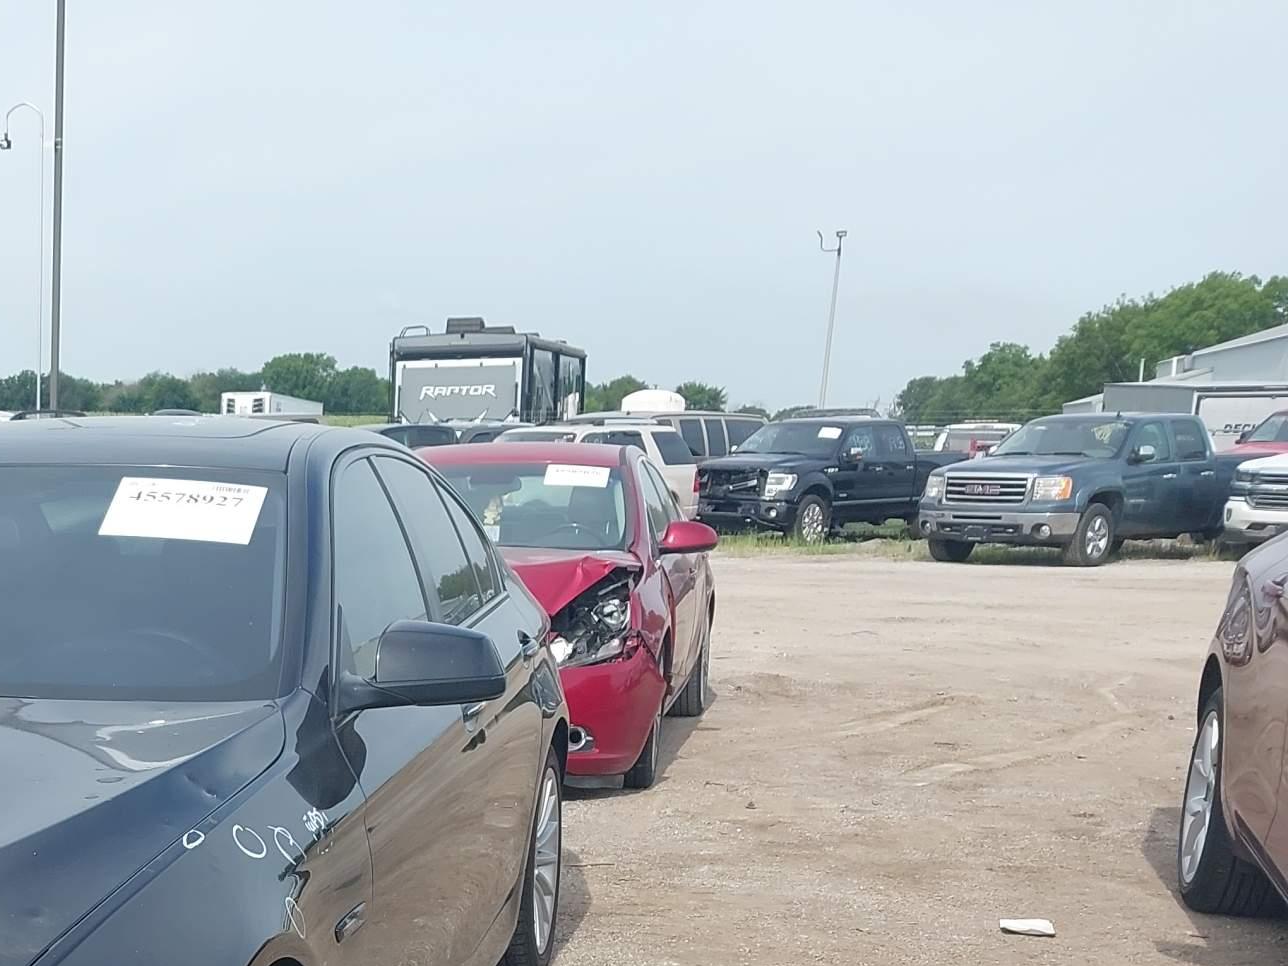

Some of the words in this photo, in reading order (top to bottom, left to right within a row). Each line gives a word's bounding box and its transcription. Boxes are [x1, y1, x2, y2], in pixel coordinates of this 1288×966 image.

[419, 384, 497, 401] RAPTOR
[965, 484, 1001, 495] GMC
[128, 490, 245, 508] 45578927
